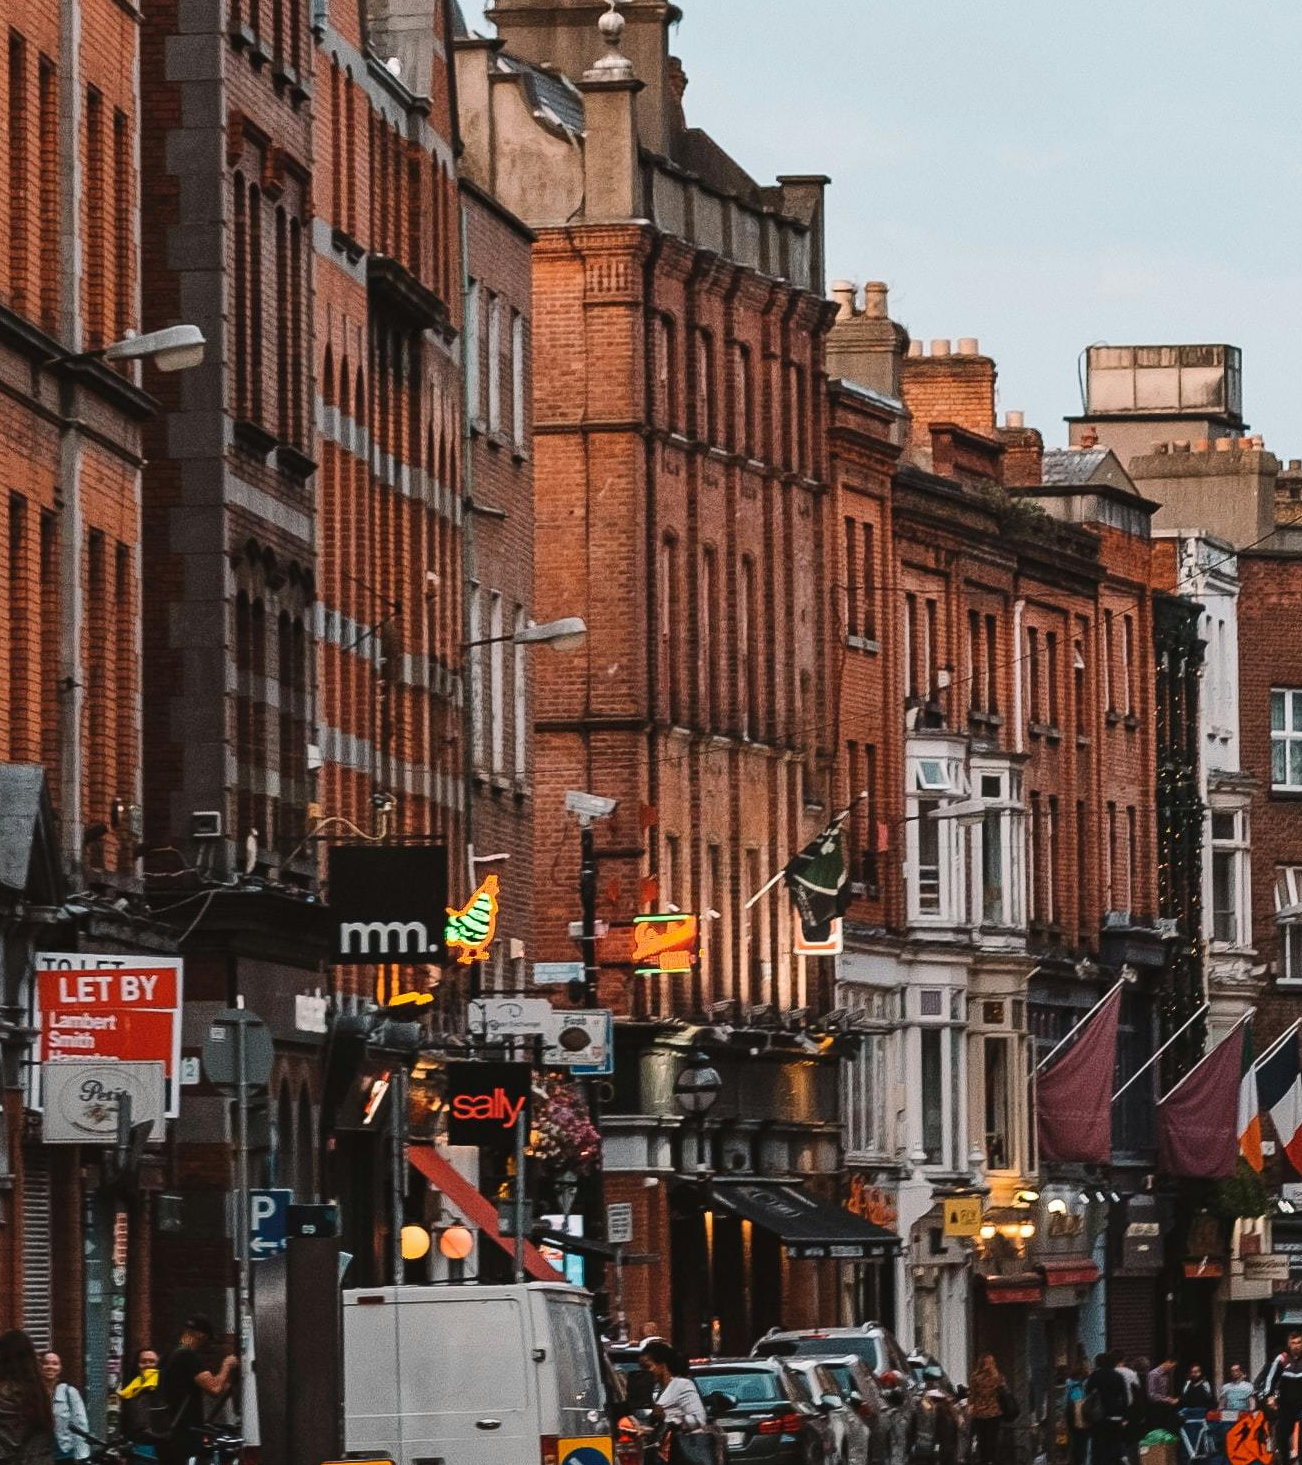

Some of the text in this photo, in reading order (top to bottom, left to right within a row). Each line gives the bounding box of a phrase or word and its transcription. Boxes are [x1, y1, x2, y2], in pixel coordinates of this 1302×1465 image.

[59, 974, 159, 1003] LET BY
[49, 1011, 117, 1030] Lambert
[49, 1031, 95, 1049] Smith
[453, 1087, 527, 1128] sally
[251, 1195, 276, 1231] P
